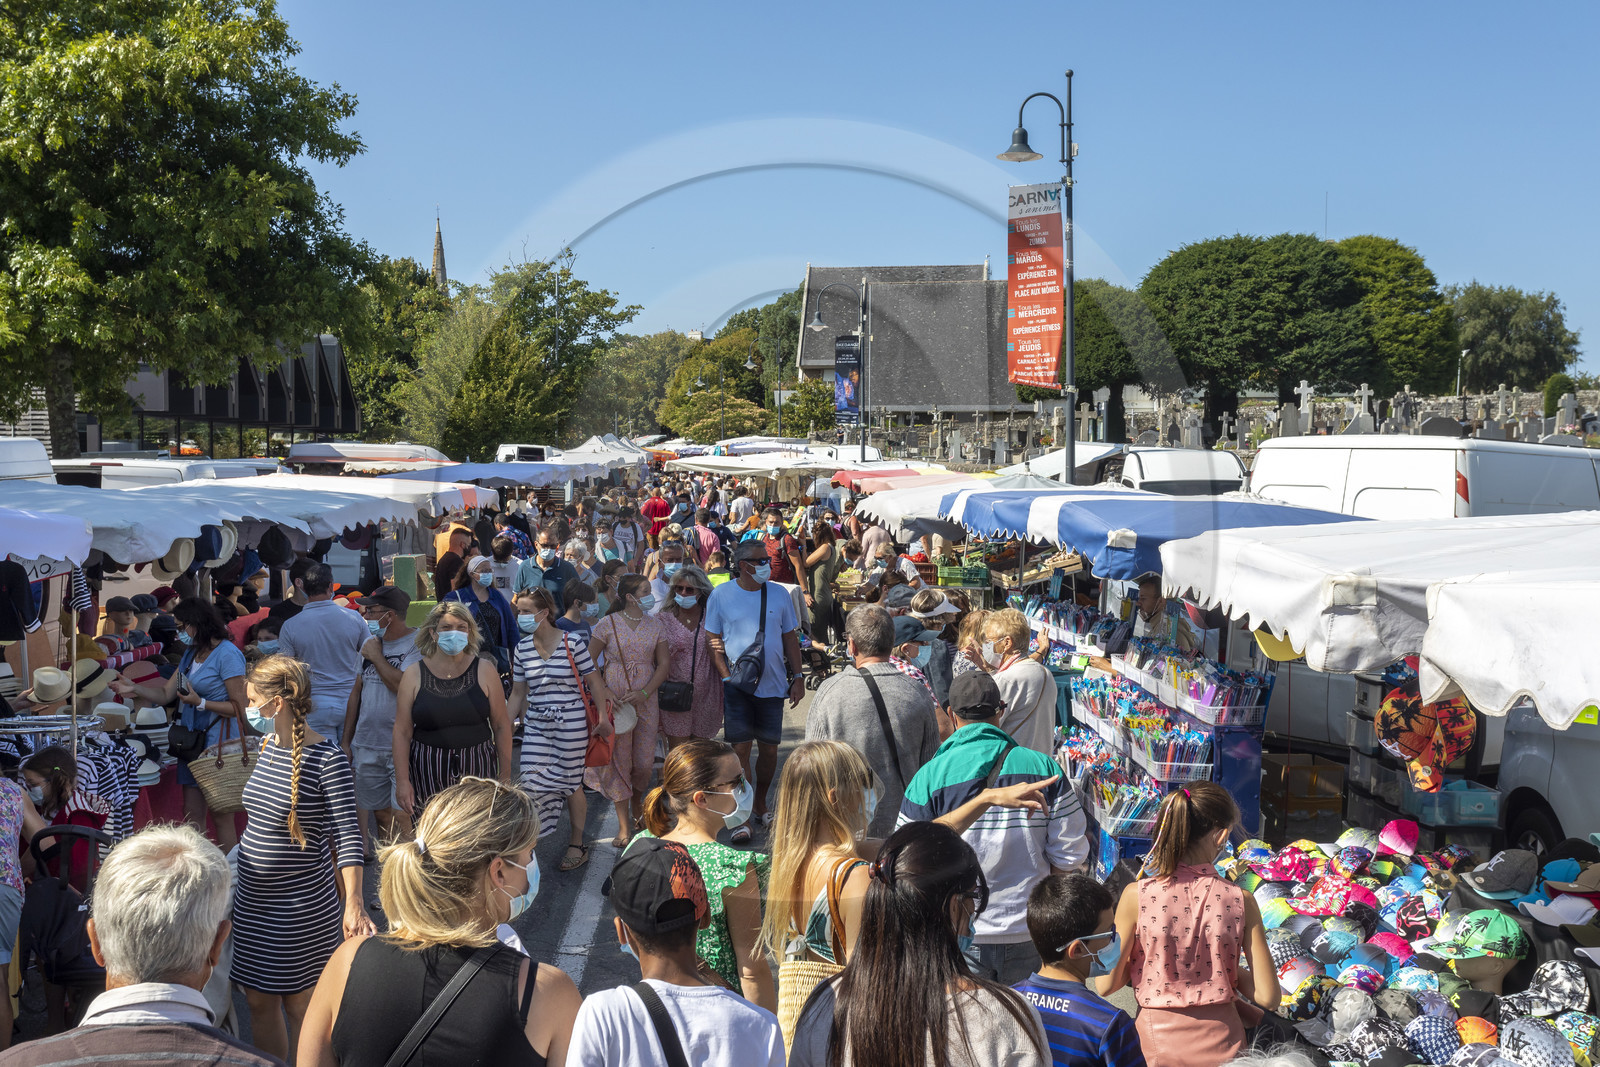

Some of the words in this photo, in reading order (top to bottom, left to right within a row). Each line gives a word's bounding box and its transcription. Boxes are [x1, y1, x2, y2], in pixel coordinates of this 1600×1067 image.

[1016, 222, 1041, 232] LUNDIS
[1029, 237, 1047, 246] ZUMBA
[1016, 254, 1043, 264] MARDIS
[1017, 270, 1047, 281] EXPÉRIENCE
[1047, 269, 1057, 277] ZEN
[1014, 289, 1030, 298] PLACE
[1030, 287, 1041, 296] AUX
[1018, 307, 1057, 318] MERCREDIS
[1012, 325, 1042, 335] EXPÉRIENCE
[1041, 323, 1061, 332] FITNESS
[1018, 343, 1042, 352] JEUDIS
[1026, 991, 1071, 1013] FRANCE
